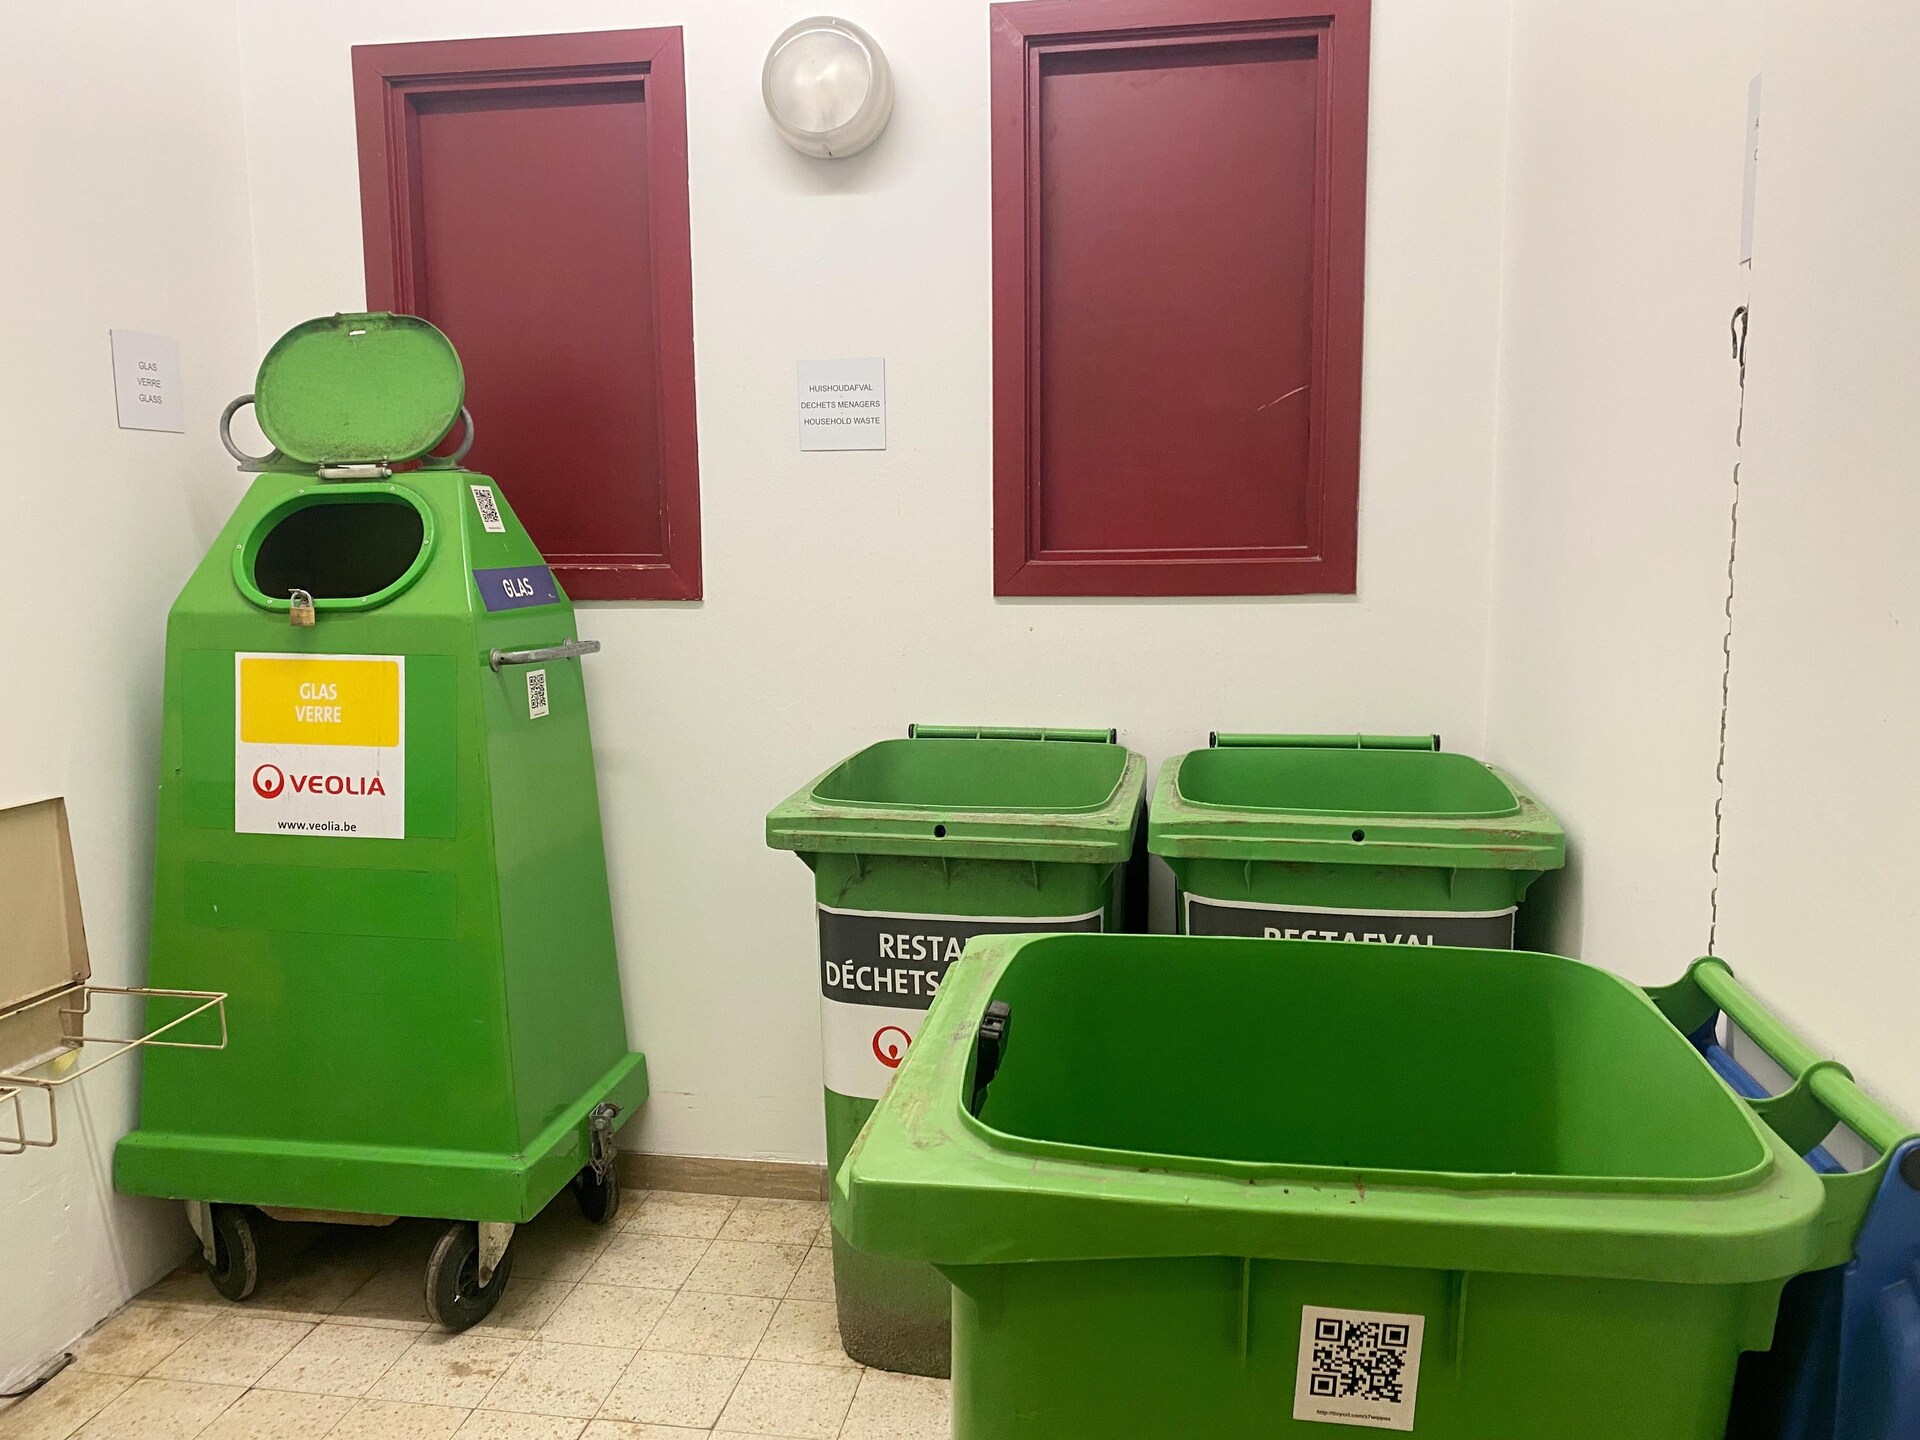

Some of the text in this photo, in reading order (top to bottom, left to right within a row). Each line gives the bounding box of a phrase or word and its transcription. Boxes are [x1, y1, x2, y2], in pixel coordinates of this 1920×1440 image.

[138, 361, 158, 371] GLAS
[137, 377, 162, 388] VERRE
[809, 384, 873, 393] HUISHOUDAFVAL
[138, 393, 163, 404] GLASS
[800, 400, 881, 409] DECHETS MENAGERS
[803, 416, 881, 425] HOUSEHOLD WASTE
[502, 577, 534, 599] GLAS
[299, 683, 338, 701] GLAS
[295, 705, 342, 723] VERRE
[289, 774, 386, 796] VEOLIA
[277, 821, 357, 832] www.veolia.be
[878, 932, 969, 962] RESTA
[825, 959, 941, 996] DÉCHETS
